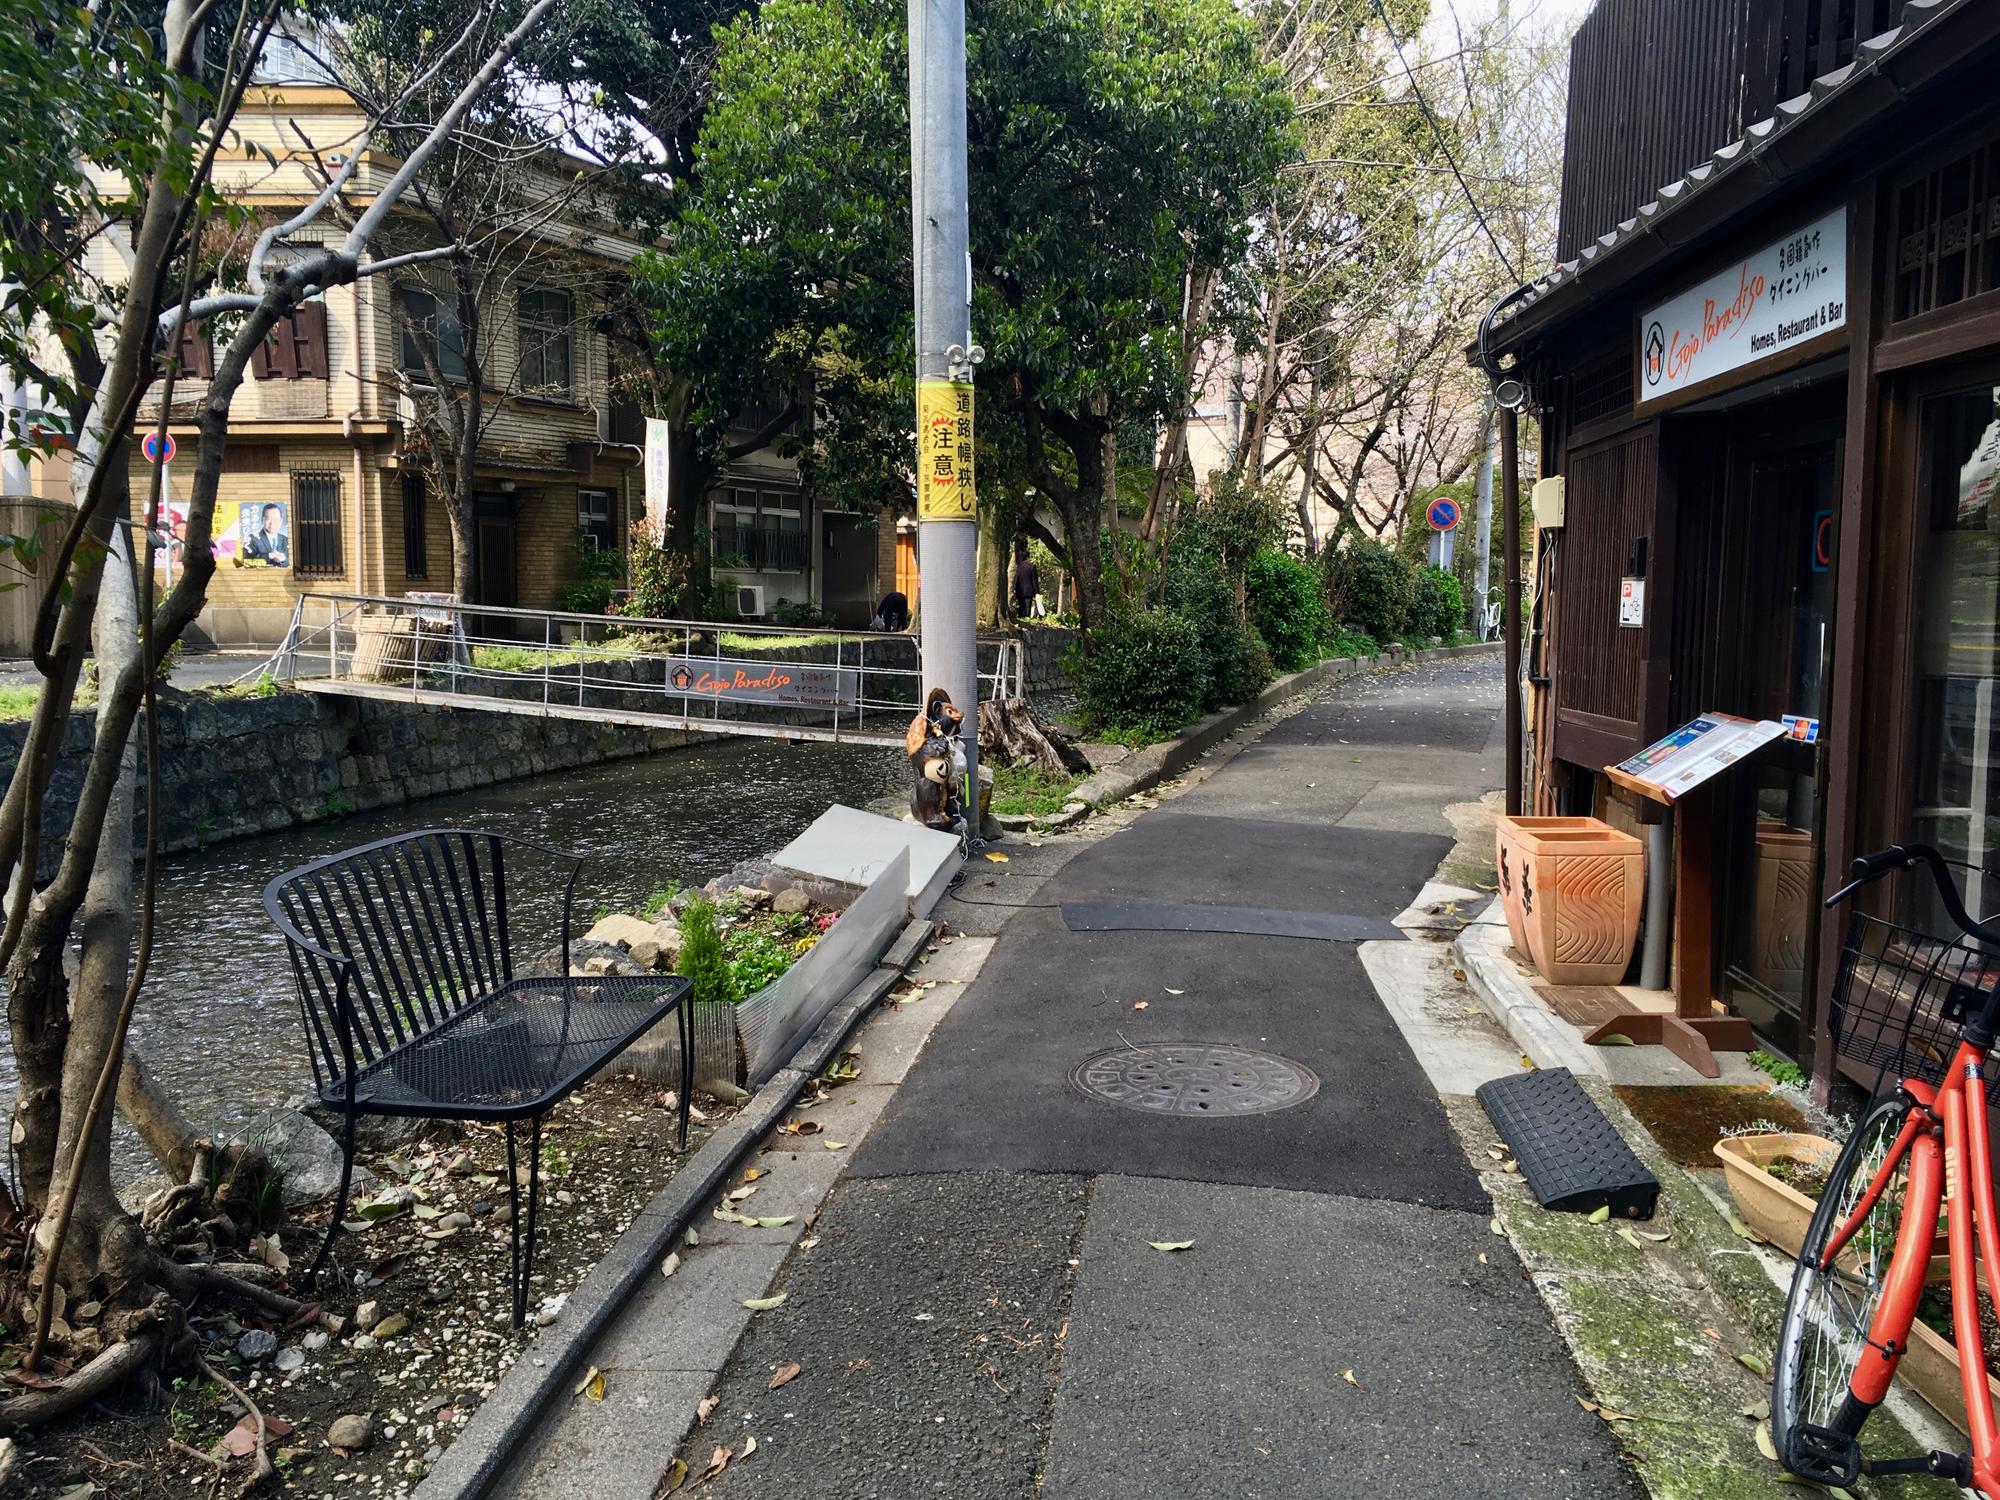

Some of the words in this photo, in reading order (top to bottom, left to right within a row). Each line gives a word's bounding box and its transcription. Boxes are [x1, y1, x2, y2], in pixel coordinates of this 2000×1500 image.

[1770, 261, 1828, 305] ダイニングバー
[1667, 329, 1699, 384] Gojo
[1700, 259, 1765, 353] Paradiso
[1751, 331, 1777, 354] Homes,
[1778, 309, 1819, 344] Restaurant
[1820, 305, 1827, 326] &
[1829, 301, 1844, 323] Bar
[932, 427, 954, 476] 注意
[956, 392, 972, 512] 道路幅狭し
[695, 672, 730, 696] Gojo
[731, 665, 791, 692] Paradiso
